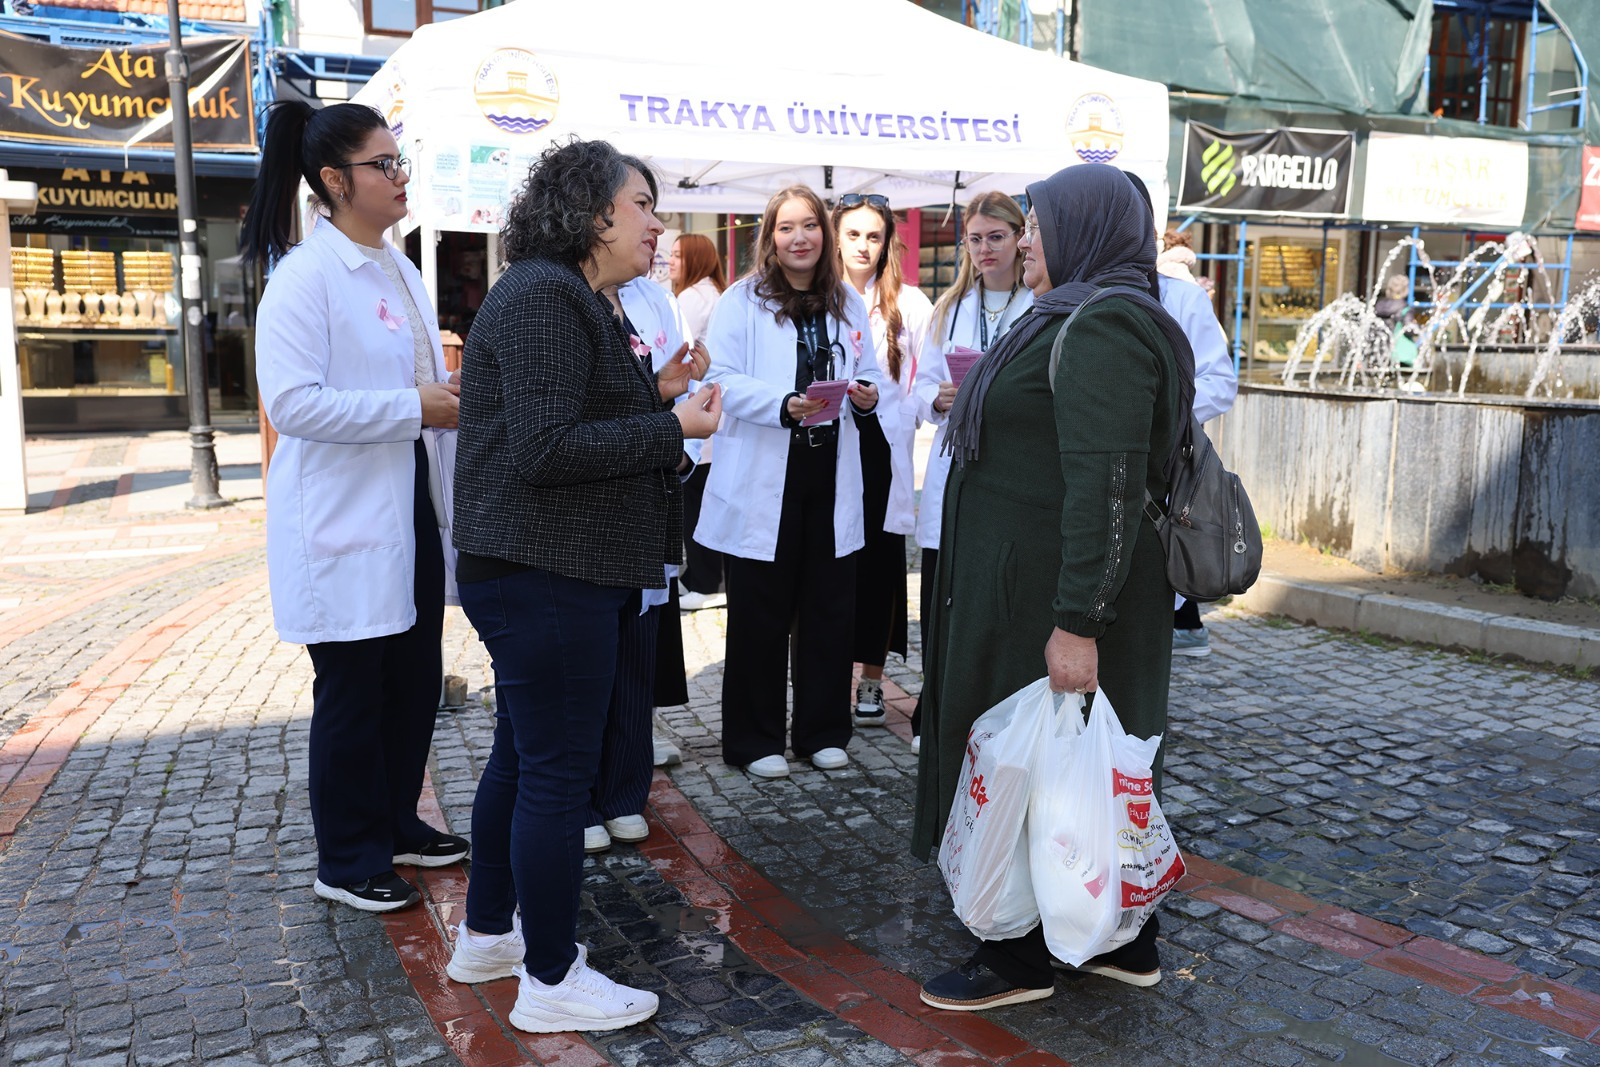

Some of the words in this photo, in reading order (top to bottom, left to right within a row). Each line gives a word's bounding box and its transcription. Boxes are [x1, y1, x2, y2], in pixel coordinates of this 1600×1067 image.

[81, 47, 156, 88] Ata
[0, 73, 241, 130] Kuyumcuk
[619, 93, 776, 131] TRAKYA
[786, 101, 1023, 143] ÜNİVERSİTESİ
[1240, 154, 1339, 191] BARGELLO
